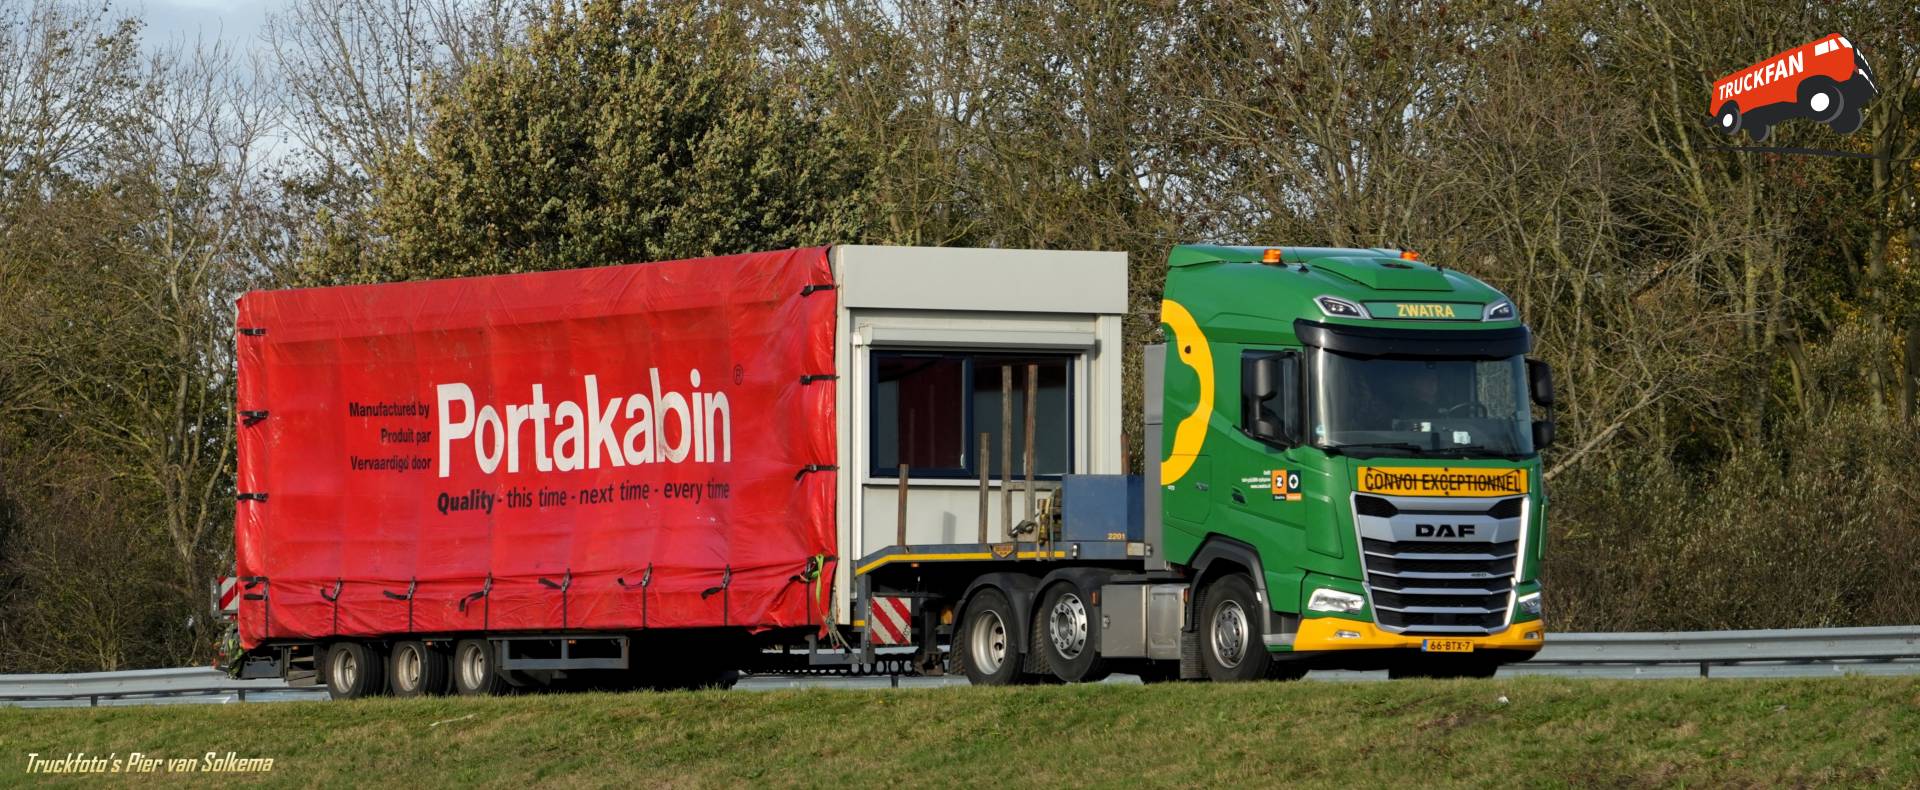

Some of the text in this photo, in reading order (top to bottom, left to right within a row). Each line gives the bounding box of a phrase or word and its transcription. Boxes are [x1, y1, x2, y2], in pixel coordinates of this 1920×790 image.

[1396, 303, 1456, 318] ZWATRA
[349, 402, 430, 418] Manufactured by
[436, 366, 731, 478] Portakabin
[380, 428, 431, 446] Produit par
[411, 456, 432, 470] door
[1365, 472, 1521, 492] CONVOI EXCEPTIONNEL
[437, 488, 495, 515] Quality
[507, 486, 533, 509] this
[538, 486, 567, 507] time
[579, 483, 614, 505] next
[620, 480, 650, 502] time
[663, 481, 703, 504] every
[707, 477, 730, 499] time
[1415, 524, 1476, 538] DAF
[1430, 641, 1471, 651] 66-BTX-7
